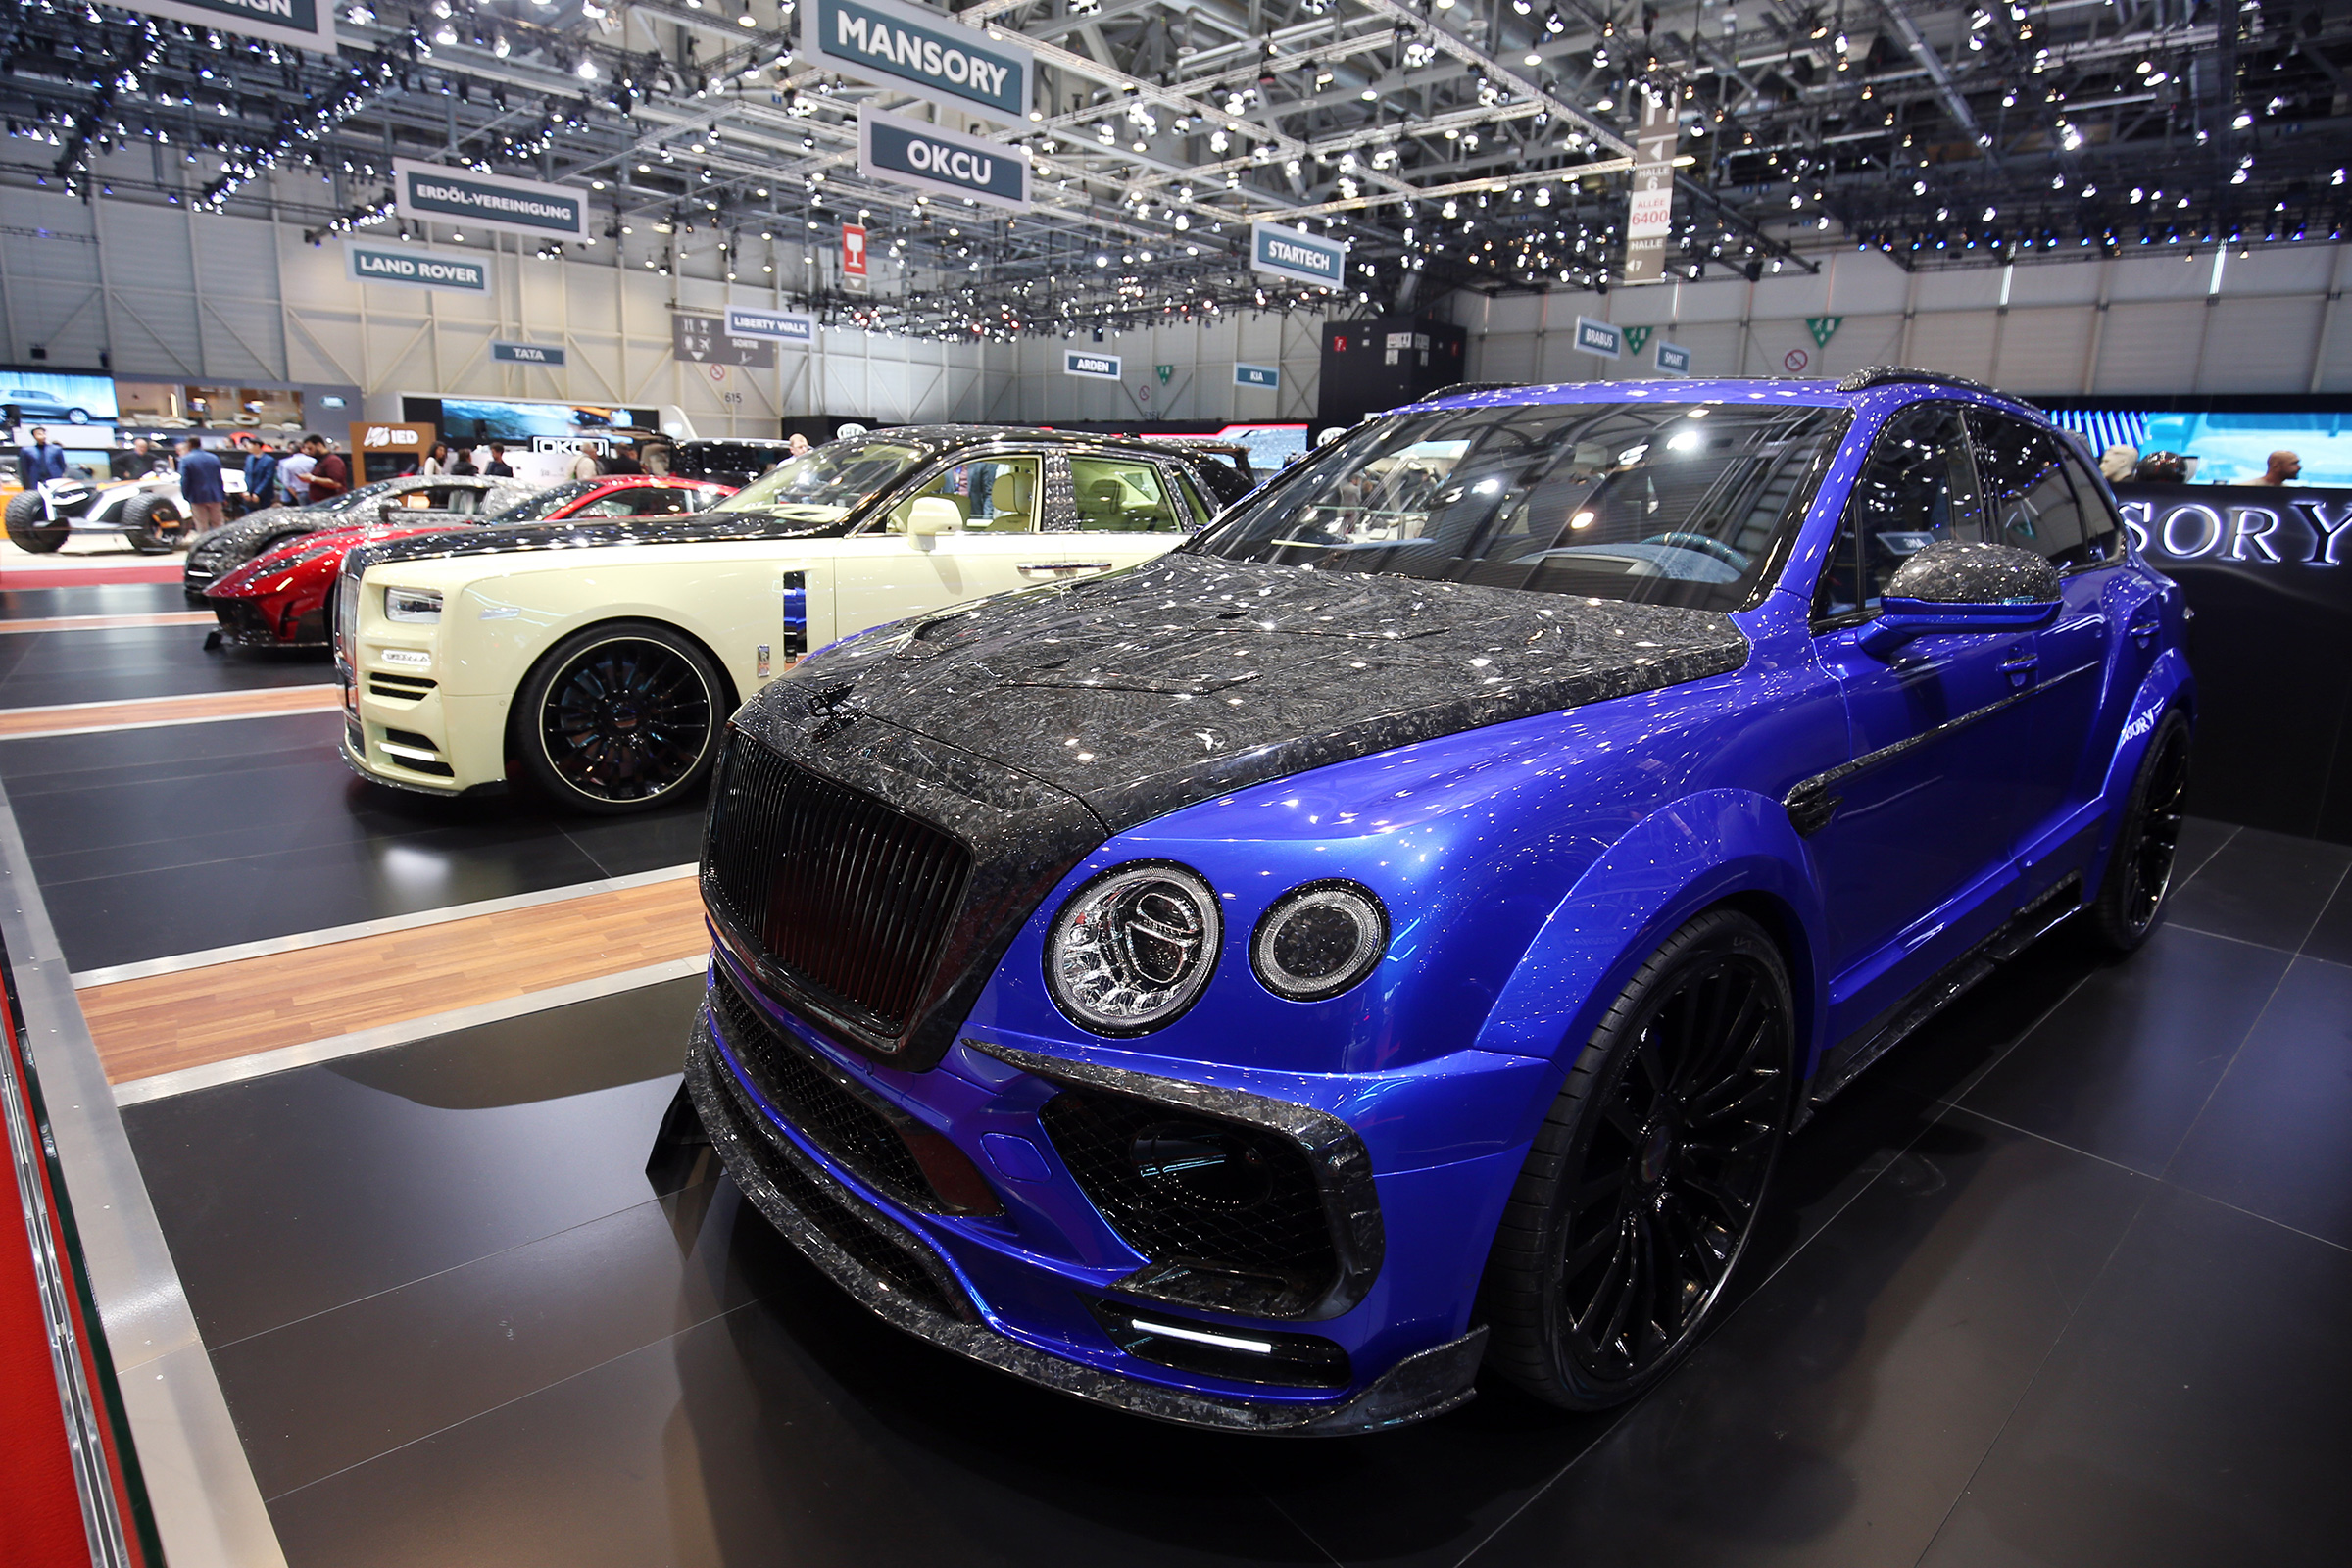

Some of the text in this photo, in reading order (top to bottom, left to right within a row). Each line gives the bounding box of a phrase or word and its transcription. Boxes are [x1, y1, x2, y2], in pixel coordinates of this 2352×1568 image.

[837, 9, 1008, 97] MANSORY
[906, 139, 992, 185] OKCU
[1639, 167, 1671, 177] HALLE
[1647, 176, 1659, 190] 6
[416, 183, 572, 220] ERDÖL-VEREINIGUNG
[1632, 210, 1668, 225] 6400
[1631, 238, 1663, 250] HALLE
[1268, 240, 1330, 270] STARTECH
[360, 255, 479, 284] LAND ROVER
[1636, 260, 1643, 271] 7
[734, 316, 808, 334] LIBERTY WALK
[1586, 327, 1613, 348] BRABUS
[513, 347, 545, 362] TATA
[1664, 351, 1683, 367] SMART
[1077, 358, 1109, 373] ARDEN
[1250, 370, 1264, 382] KIA
[724, 393, 742, 403] 615
[391, 429, 418, 444] IED
